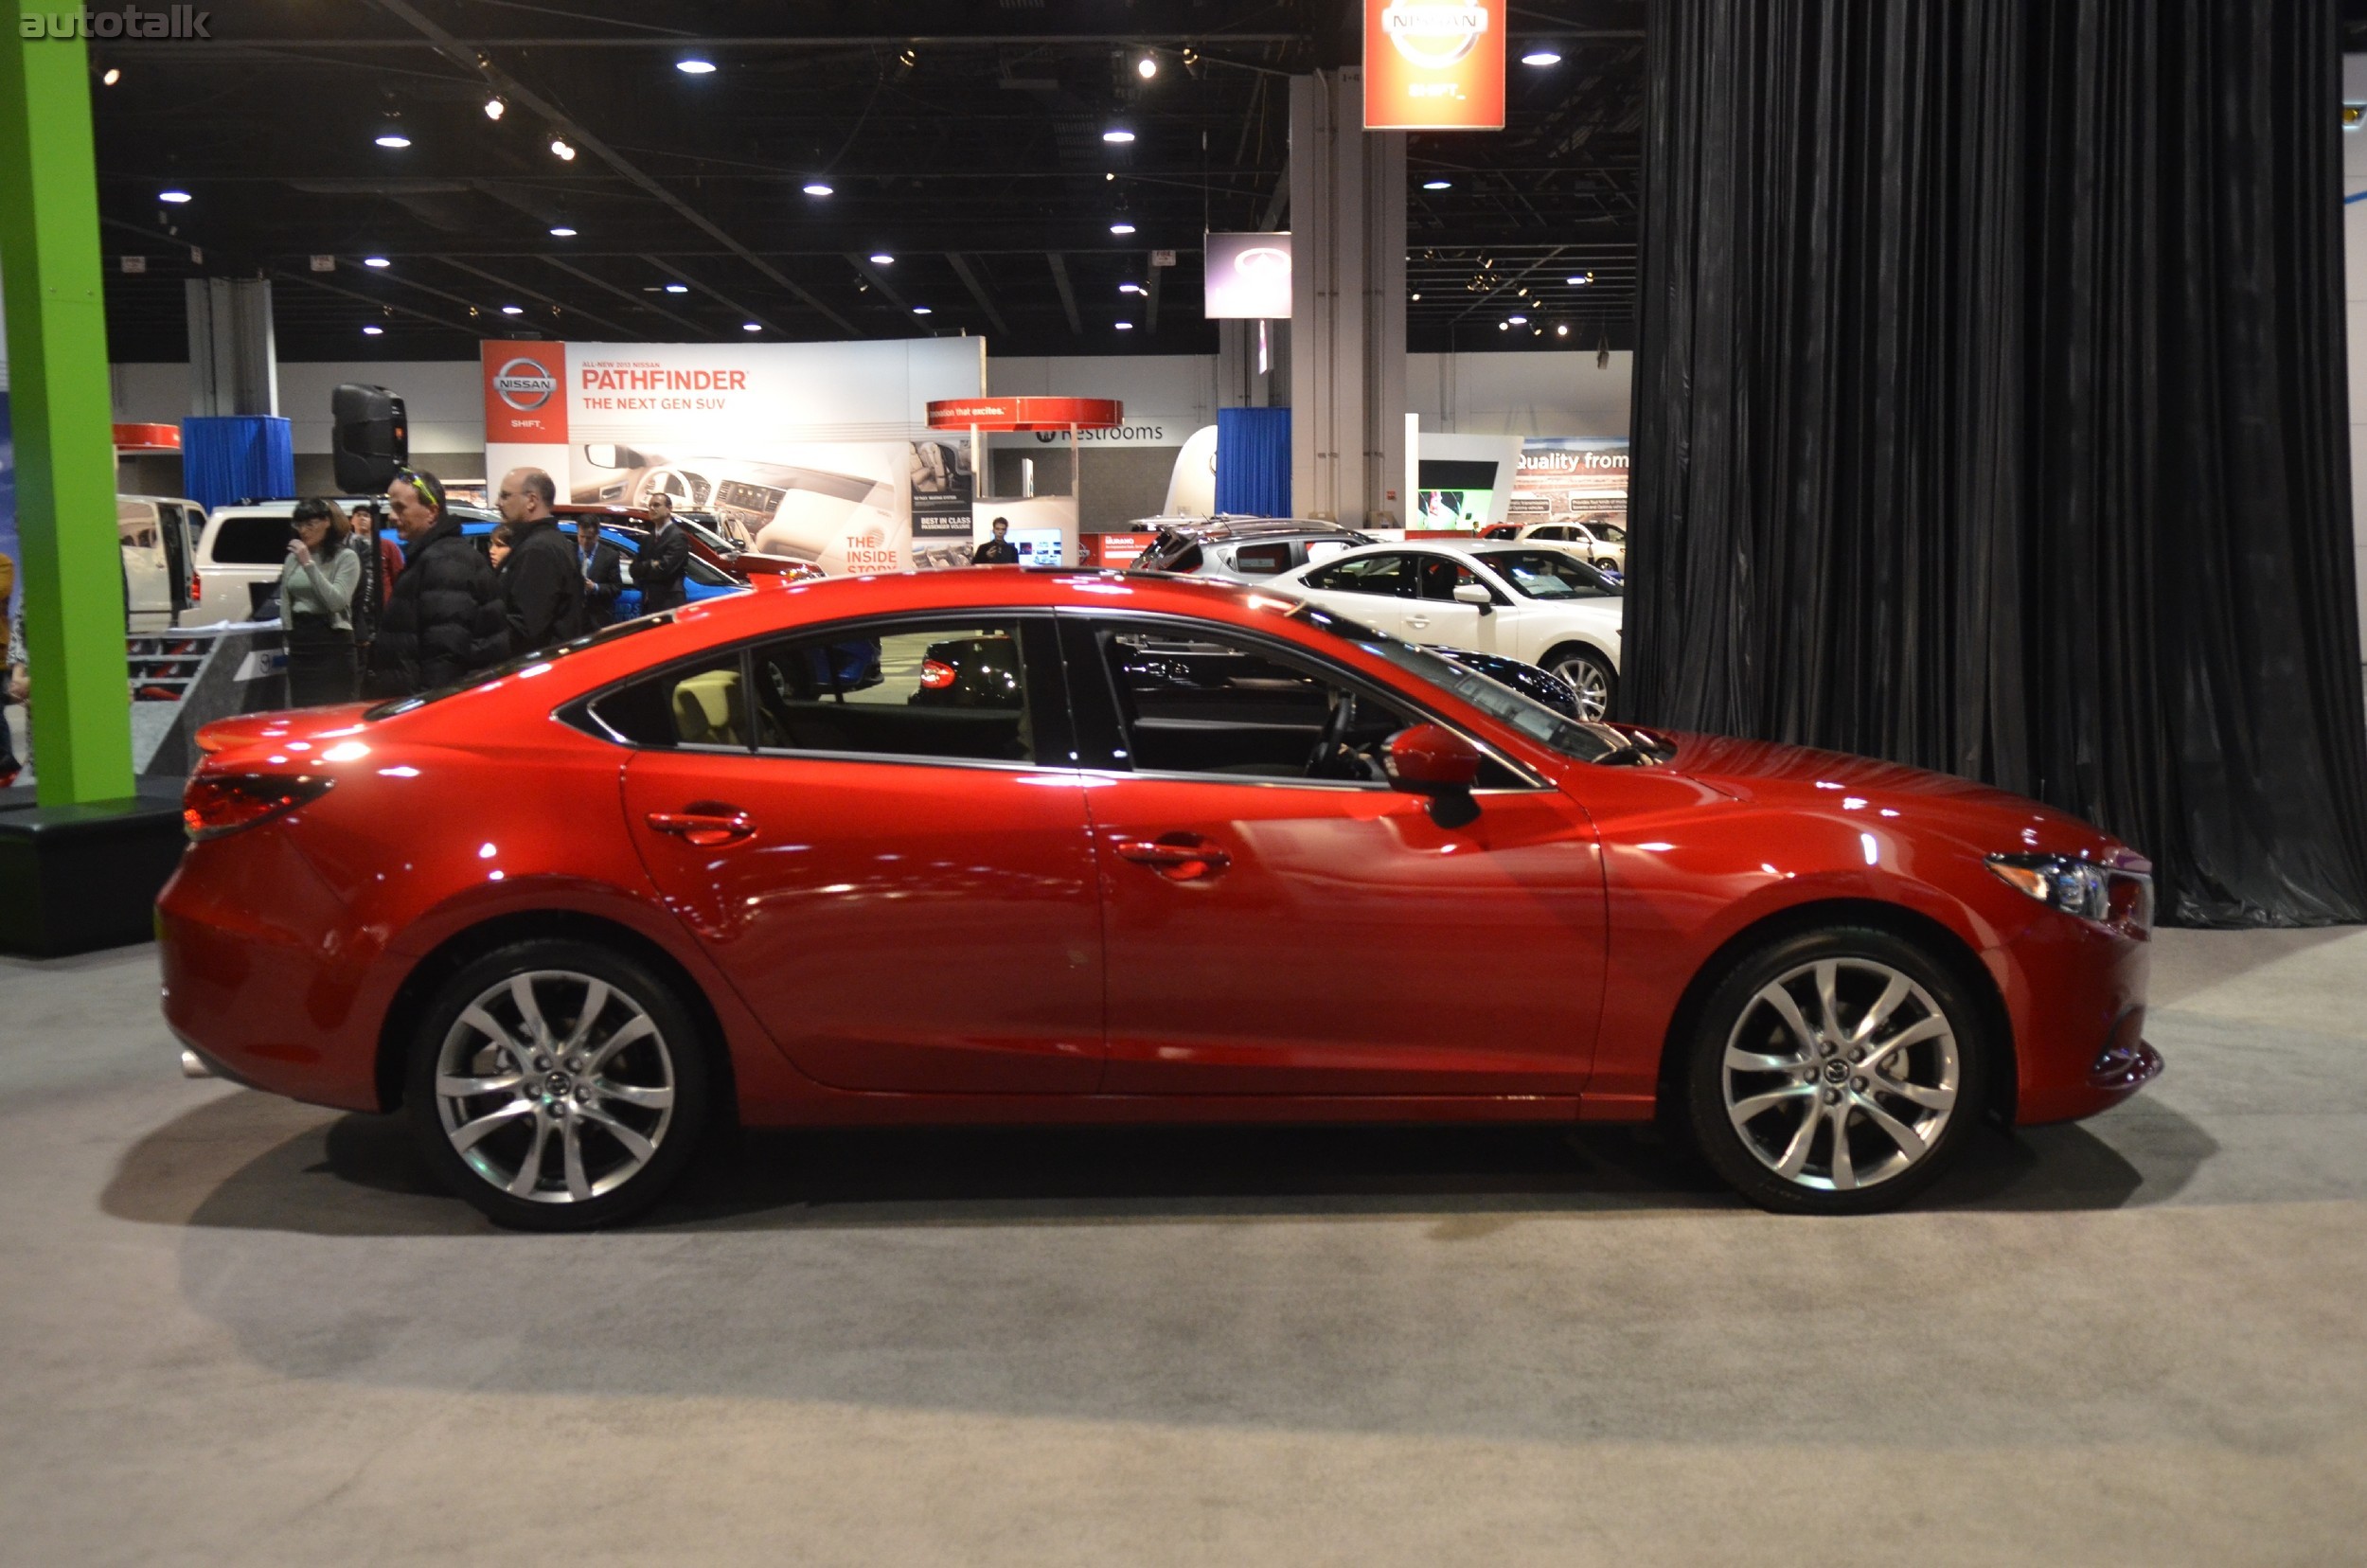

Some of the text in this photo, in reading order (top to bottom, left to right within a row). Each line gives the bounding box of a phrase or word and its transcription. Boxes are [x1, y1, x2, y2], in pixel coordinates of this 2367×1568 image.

[1393, 15, 1477, 27] NIAN
[499, 380, 550, 389] NISSAN
[582, 369, 746, 390] PATHFINDER
[583, 398, 725, 410] THE NEXT GEN SUV
[955, 407, 971, 417] that
[1585, 452, 1628, 470] from
[847, 536, 875, 548] THE
[847, 551, 898, 562] INSIDE
